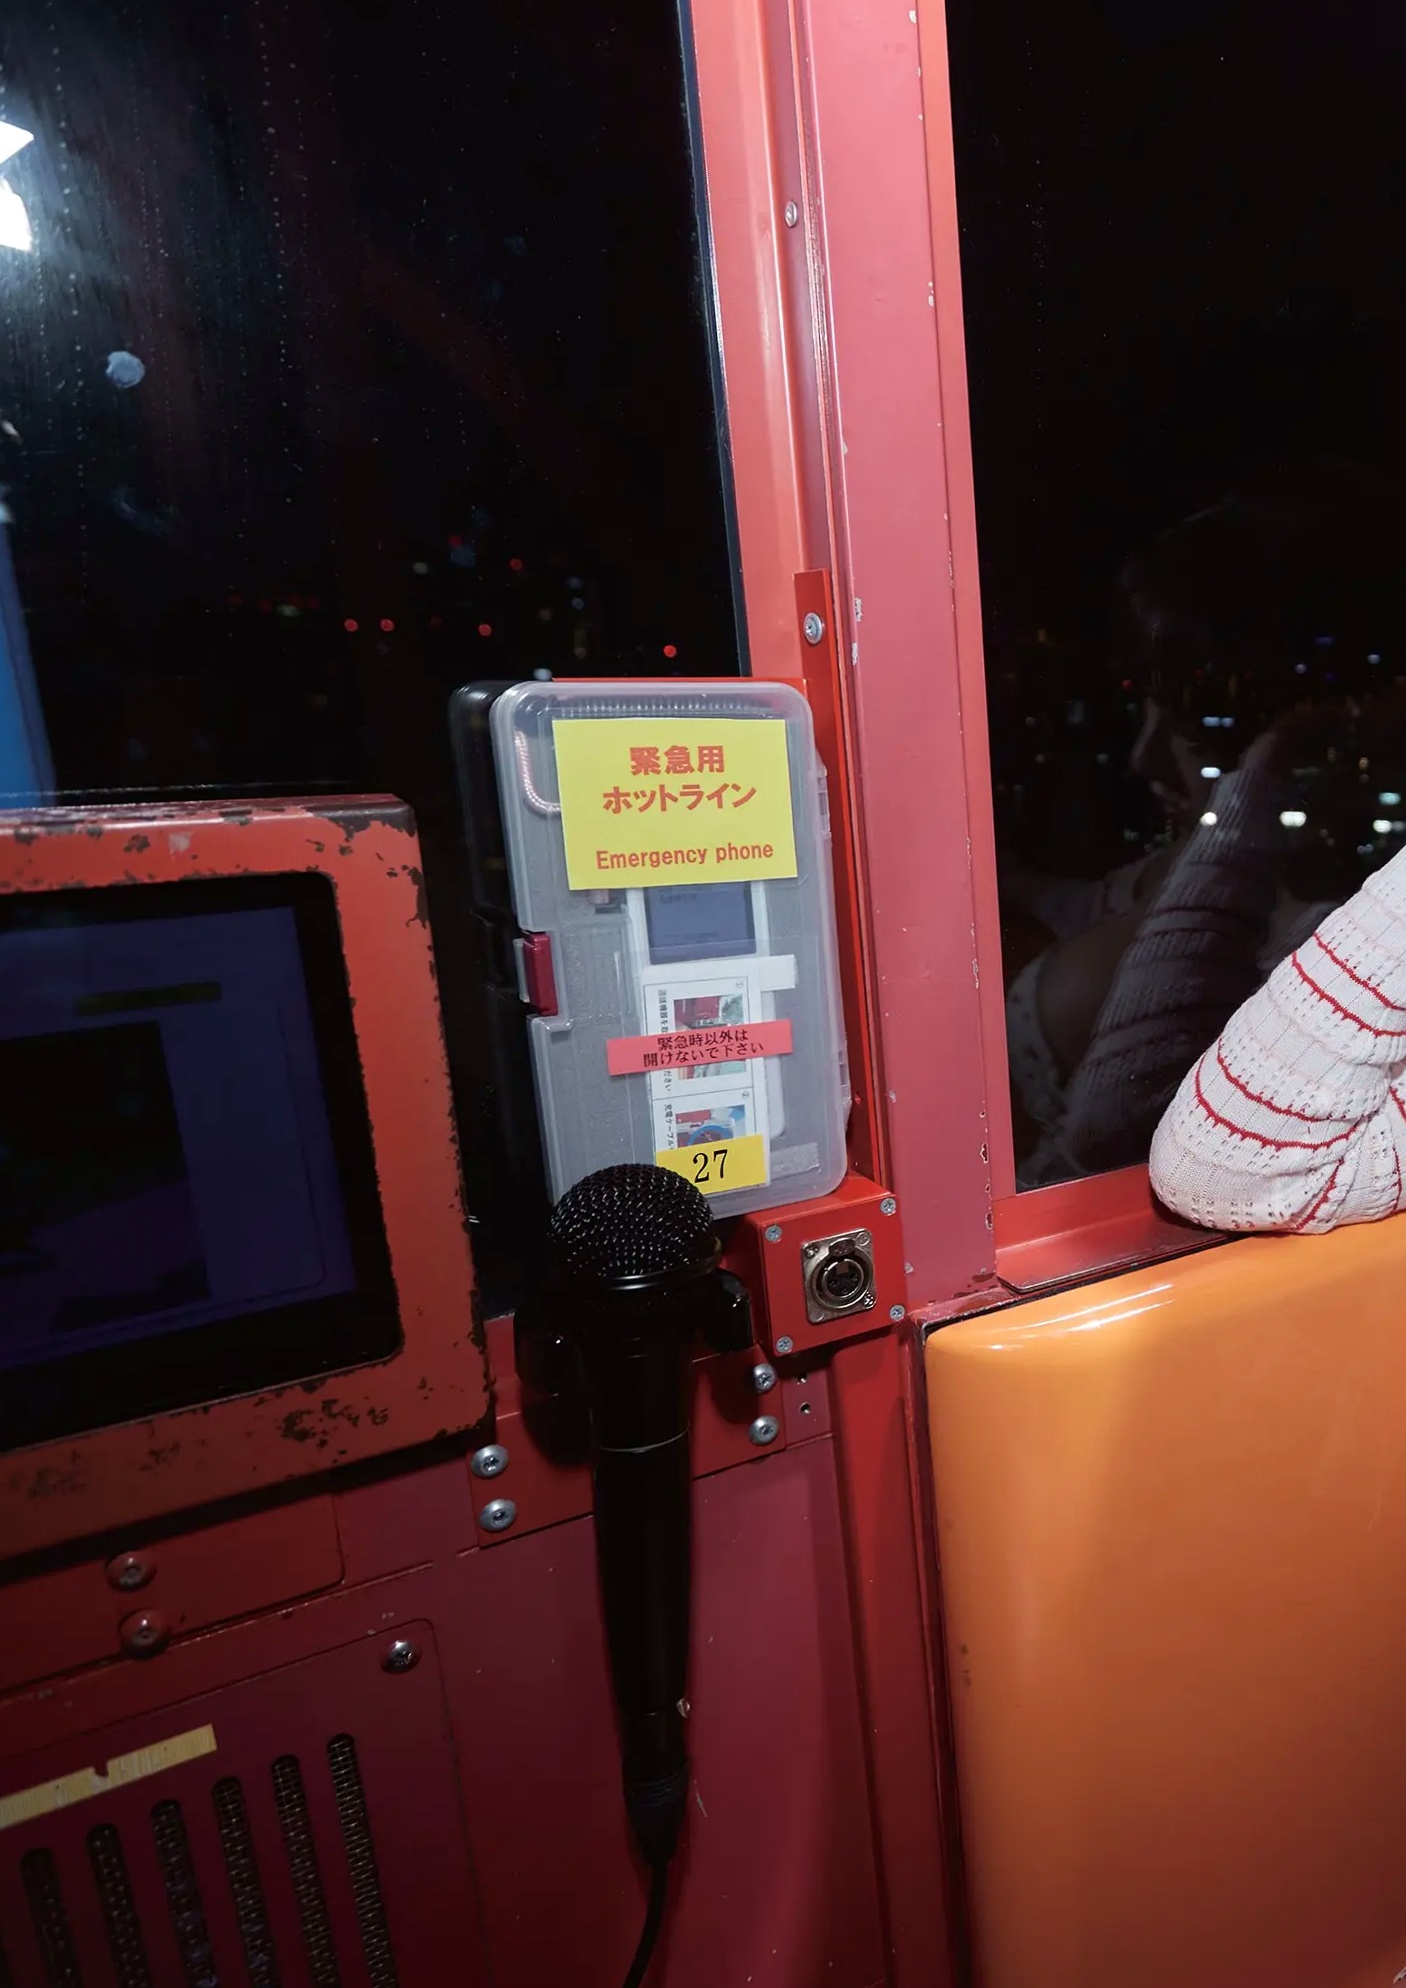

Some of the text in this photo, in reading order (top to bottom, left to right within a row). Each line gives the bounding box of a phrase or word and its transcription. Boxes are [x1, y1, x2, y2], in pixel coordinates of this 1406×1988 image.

[630, 745, 725, 775] 緊急用
[602, 783, 757, 813] ホットライン
[596, 842, 774, 869] Emergency phone
[657, 1029, 749, 1051] 緊急時以外は
[643, 1041, 764, 1068] 開けないで下さい
[692, 1149, 728, 1183] 27
